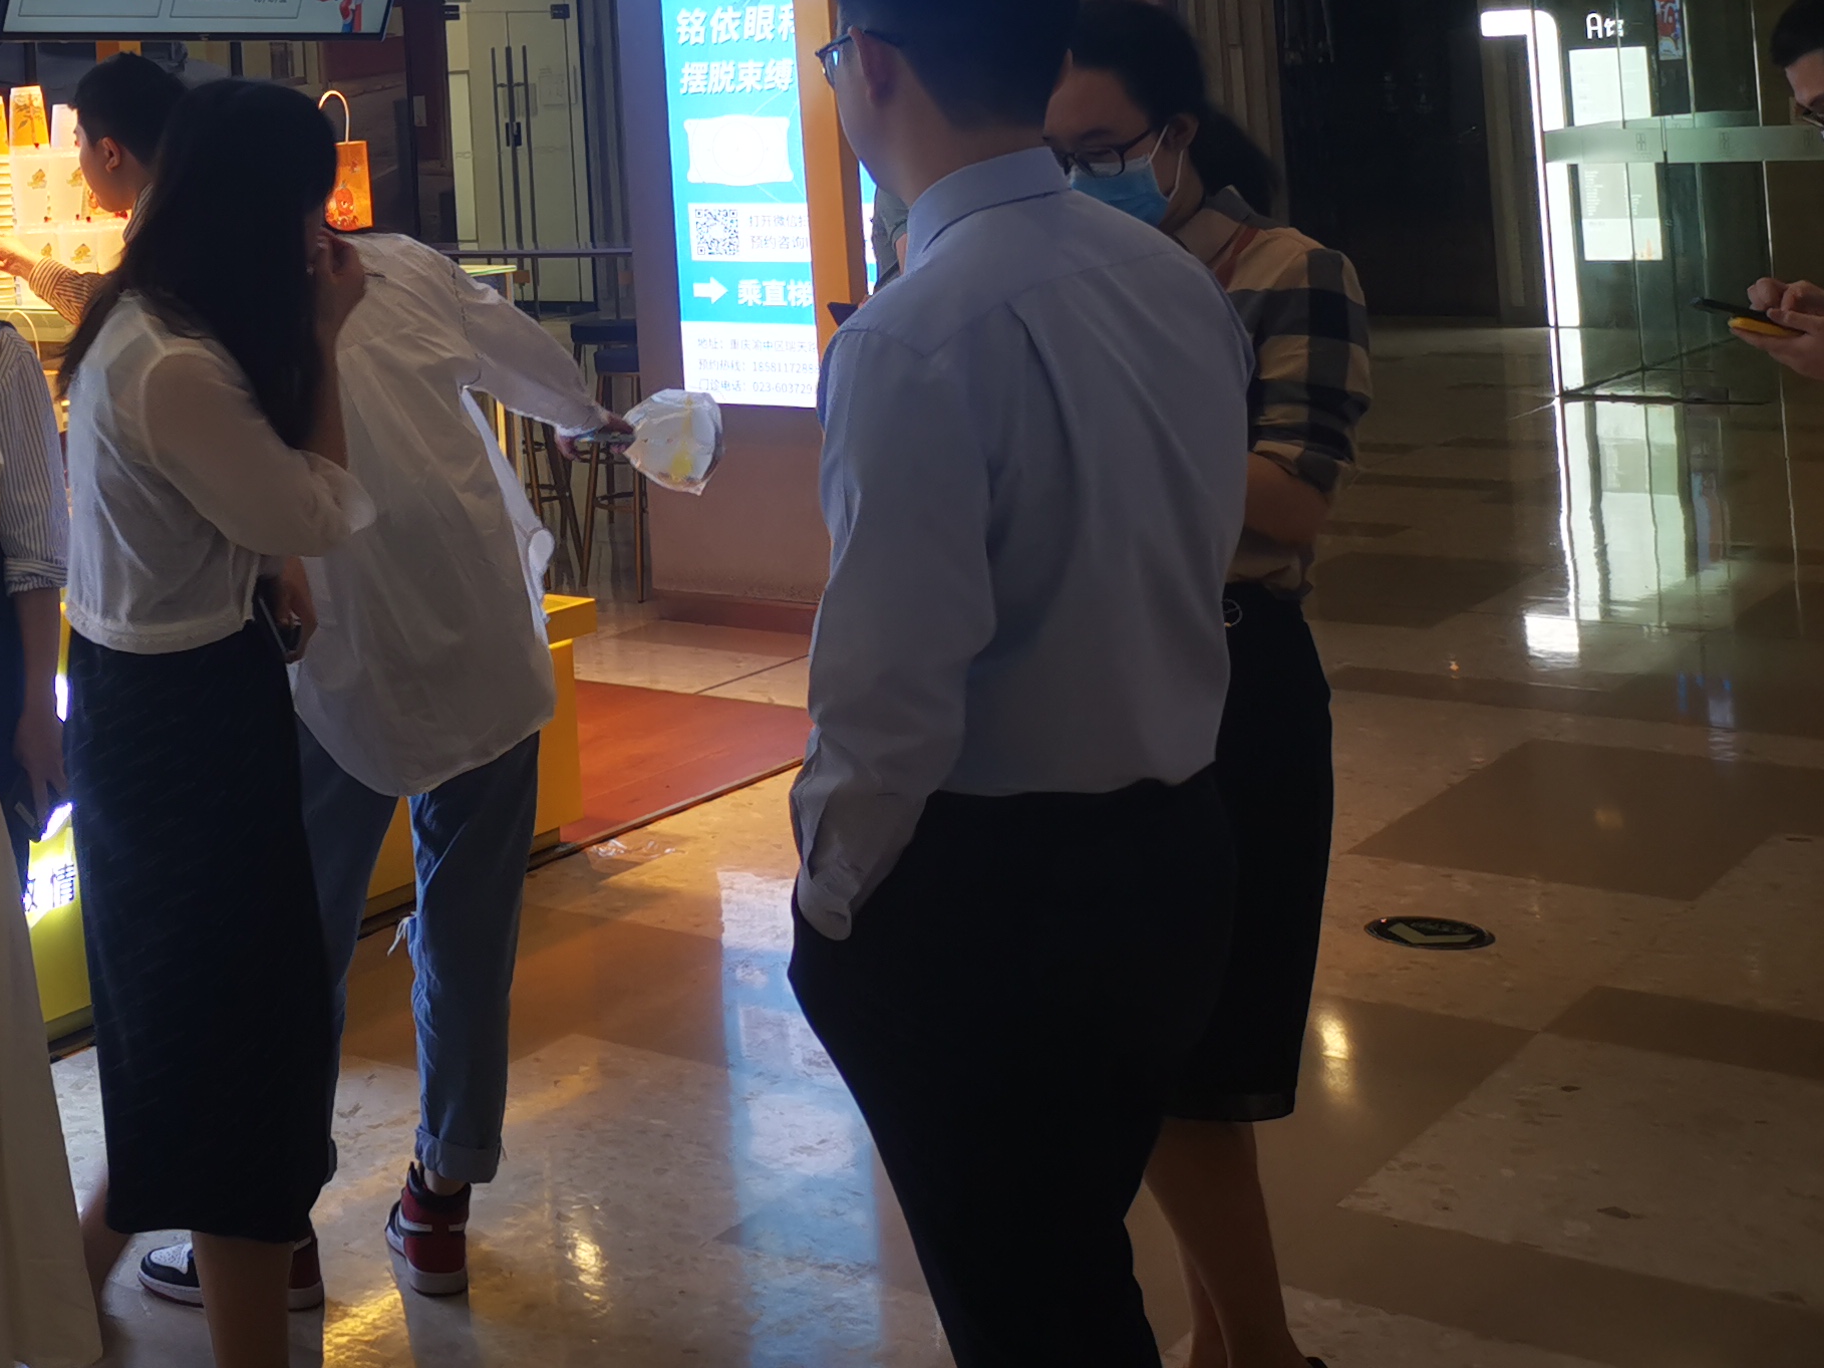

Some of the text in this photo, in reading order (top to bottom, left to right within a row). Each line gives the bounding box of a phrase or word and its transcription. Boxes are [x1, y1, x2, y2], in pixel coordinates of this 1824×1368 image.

[679, 58, 794, 94] 摆脱束缚
[737, 279, 813, 308] 乘直梯
